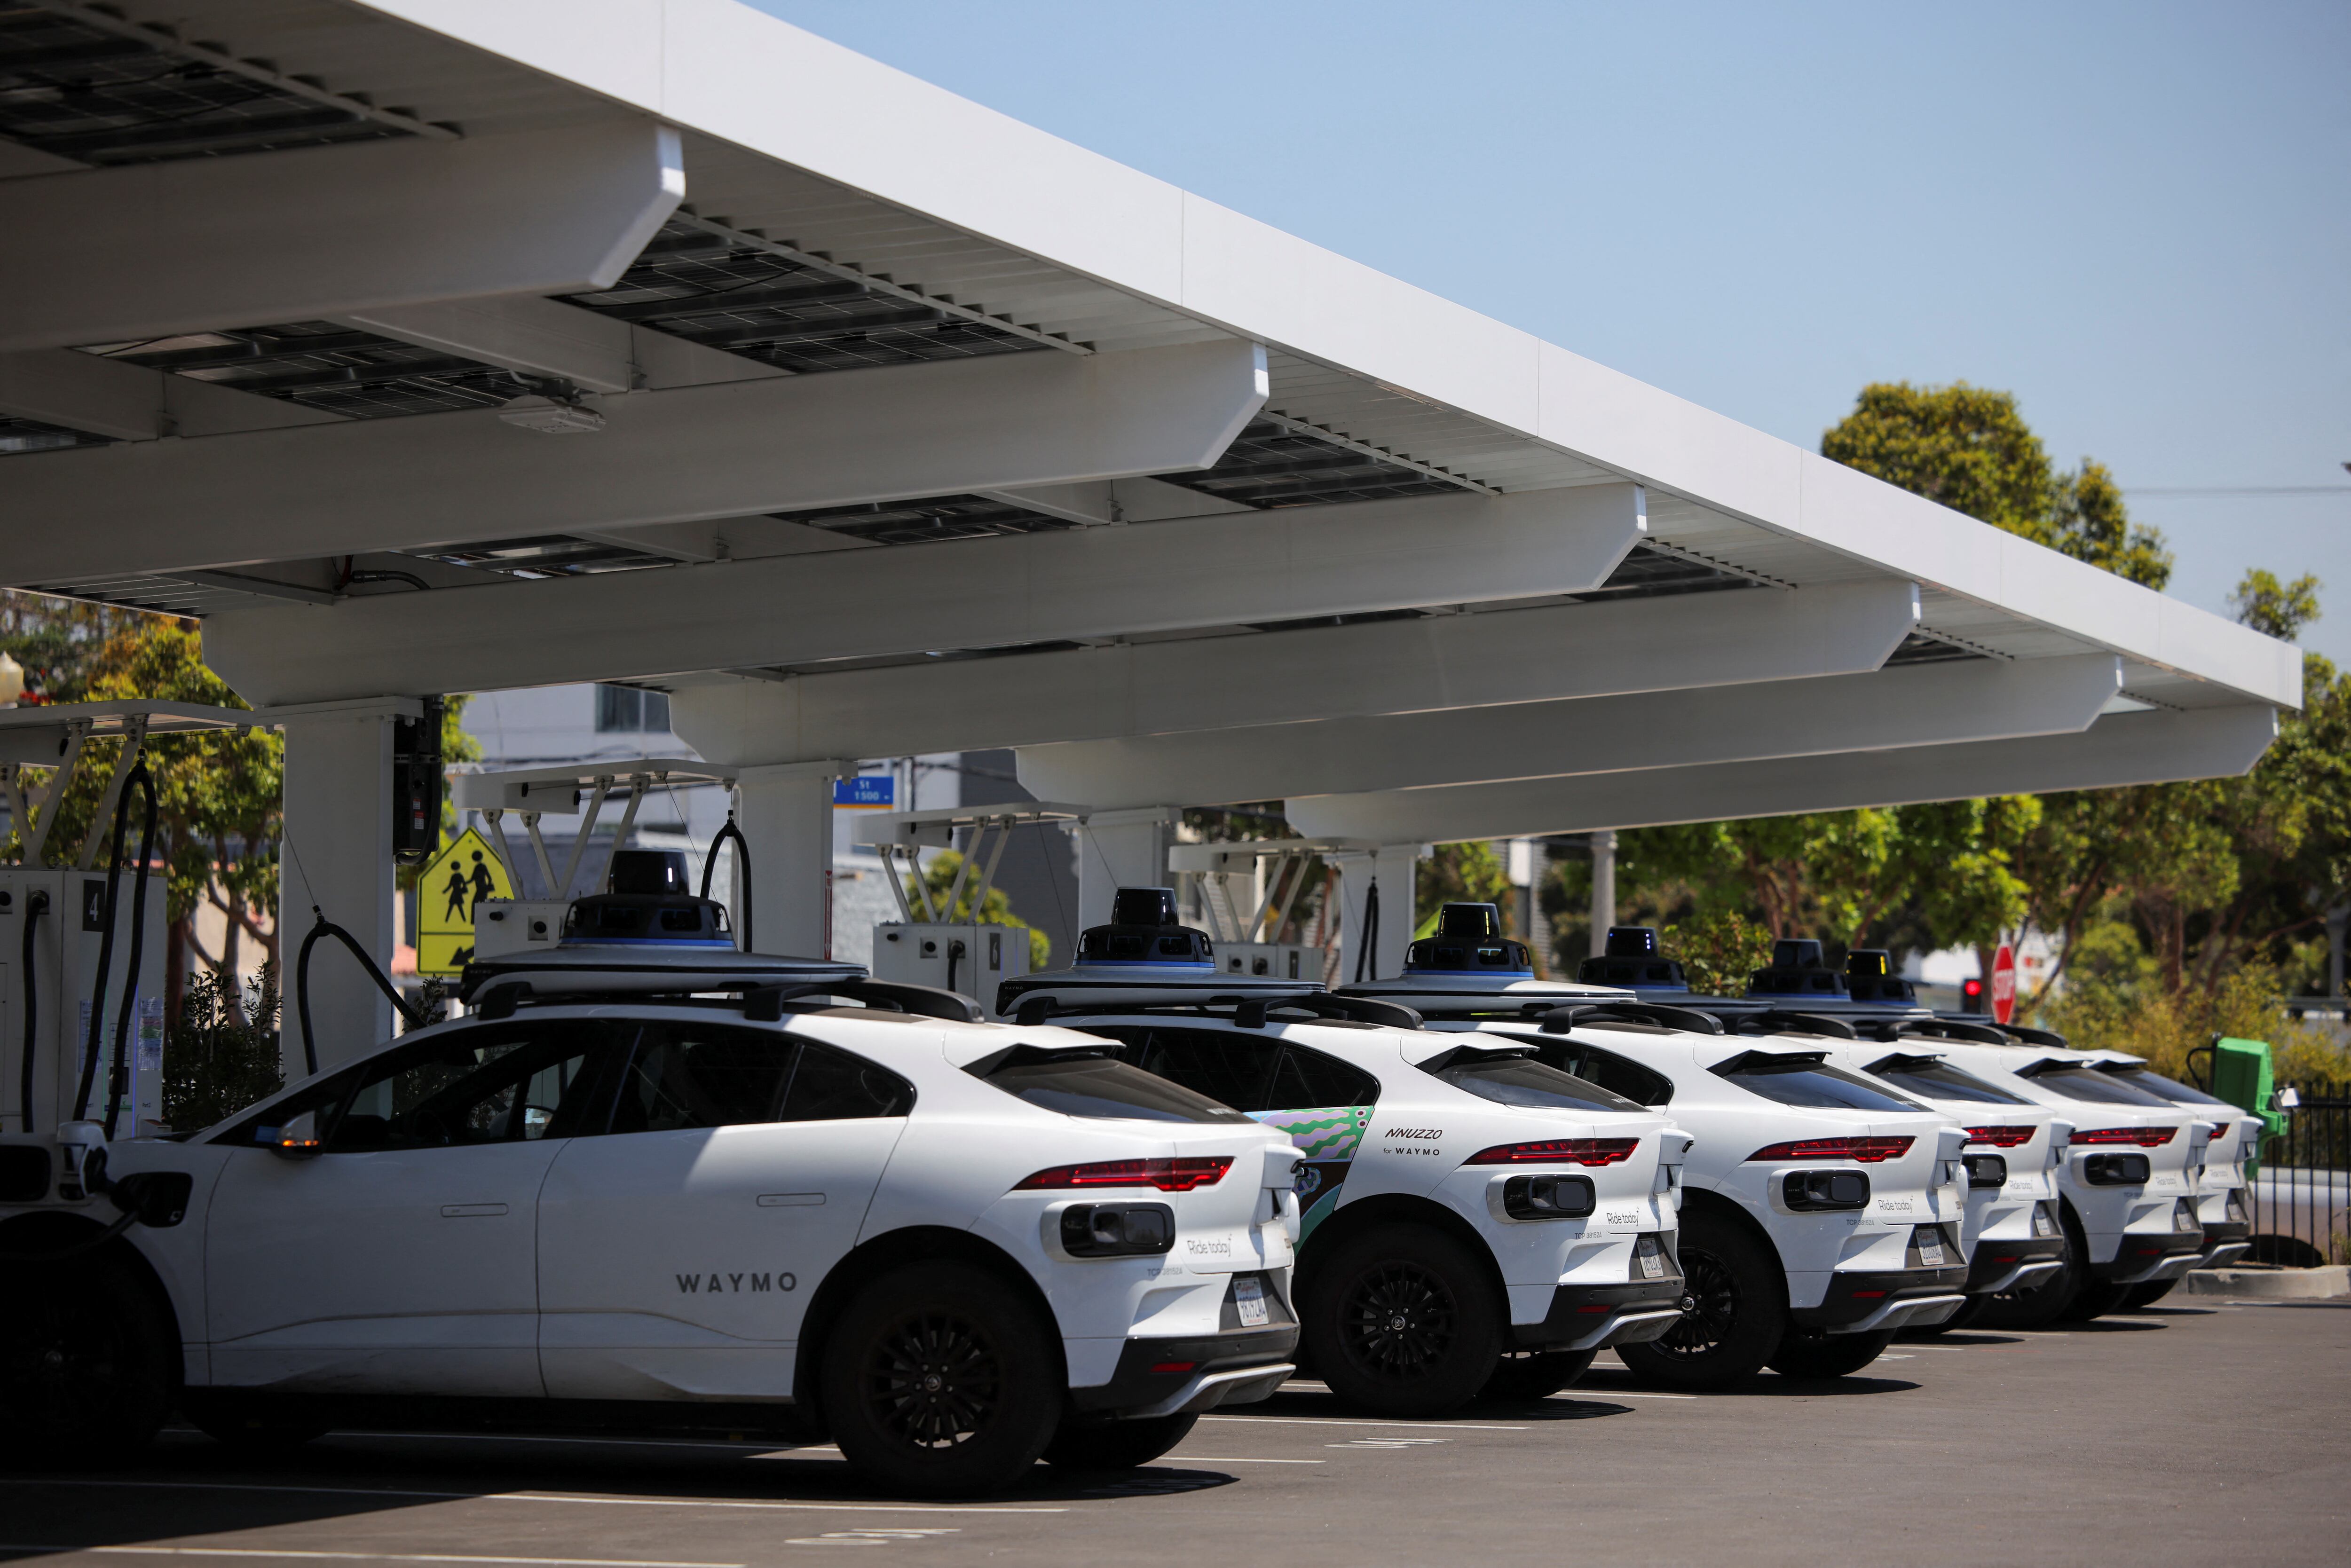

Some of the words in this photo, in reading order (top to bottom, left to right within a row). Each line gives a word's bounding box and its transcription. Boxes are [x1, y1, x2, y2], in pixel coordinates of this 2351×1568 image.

[859, 780, 870, 789] St
[854, 791, 880, 801] 1500
[89, 892, 98, 921] 4
[993, 942, 998, 964] 6
[1993, 969, 2014, 1001] STOP
[1385, 1128, 1443, 1140] NNUZZO
[1396, 1147, 1440, 1156] WAYMO
[1878, 1199, 1894, 1210] Ride
[1894, 1199, 1912, 1213] today
[1606, 1212, 1622, 1224] Ride
[1622, 1211, 1639, 1227] today
[1187, 1239, 1208, 1255] Ride
[1208, 1239, 1231, 1258] today
[676, 1272, 797, 1293] WAYMO
